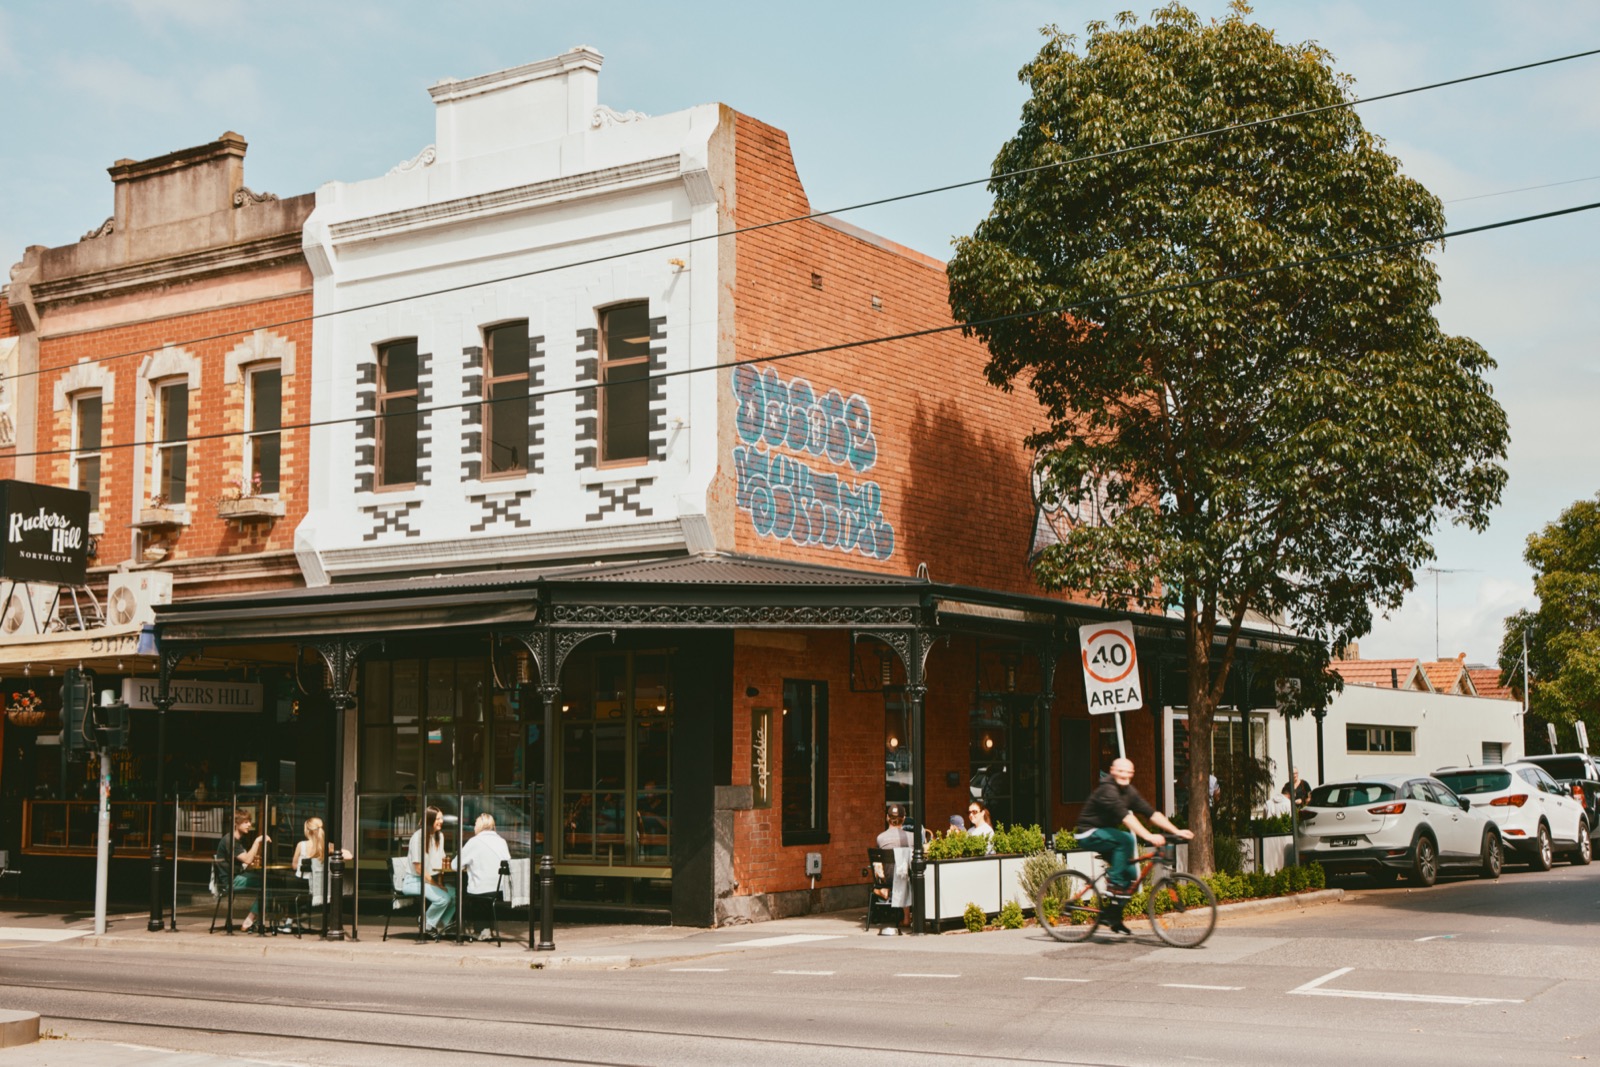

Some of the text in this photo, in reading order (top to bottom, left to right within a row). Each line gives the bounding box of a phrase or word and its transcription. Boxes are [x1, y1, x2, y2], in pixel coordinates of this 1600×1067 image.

[8, 507, 70, 543] Ruckers
[52, 527, 82, 553] Hill
[20, 551, 72, 563] NORTHCOTE
[1091, 643, 1127, 667] 40
[140, 686, 254, 705] RKERS HILL
[1090, 687, 1140, 707] AREA
